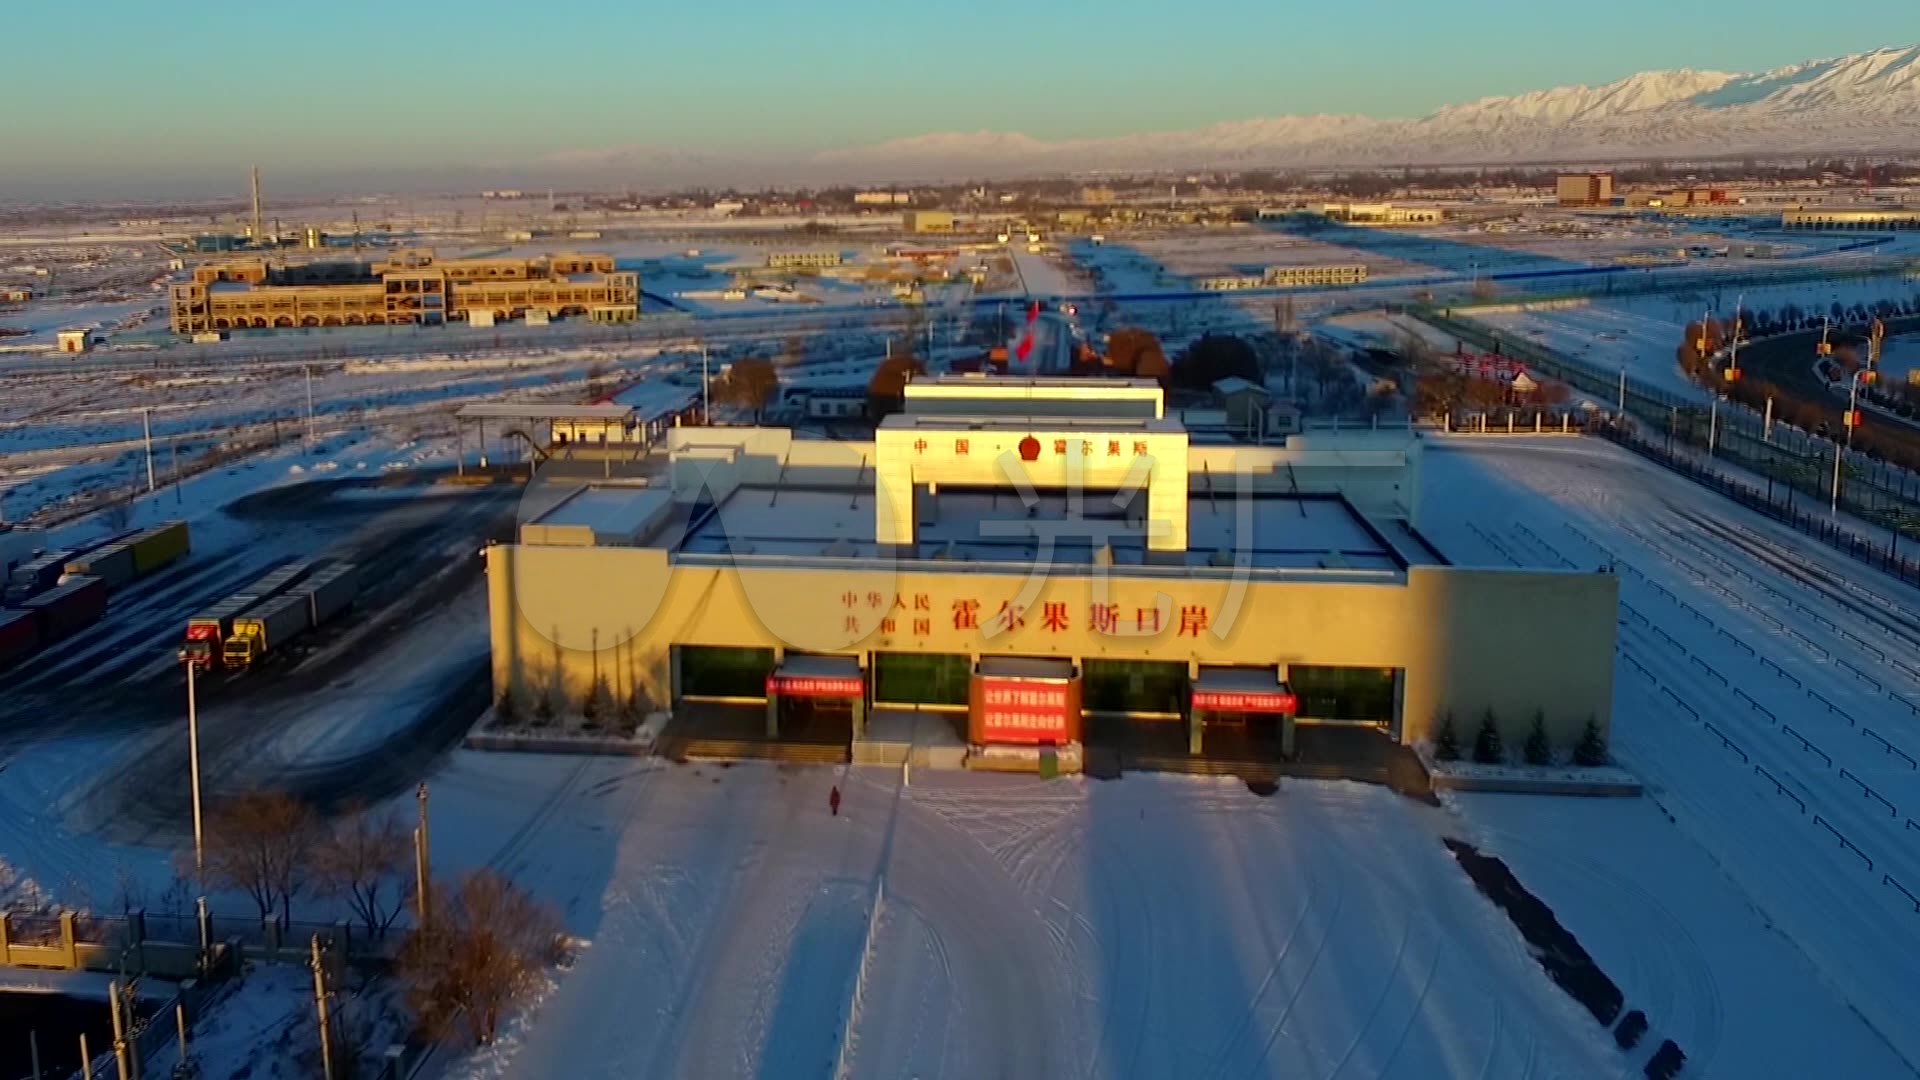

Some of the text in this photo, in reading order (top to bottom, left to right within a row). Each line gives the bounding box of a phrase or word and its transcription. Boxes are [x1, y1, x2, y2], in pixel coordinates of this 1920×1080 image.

[842, 590, 930, 612] 中华人民
[844, 616, 931, 636] 共和国
[952, 598, 1209, 638] 霍尔果斯口岸
